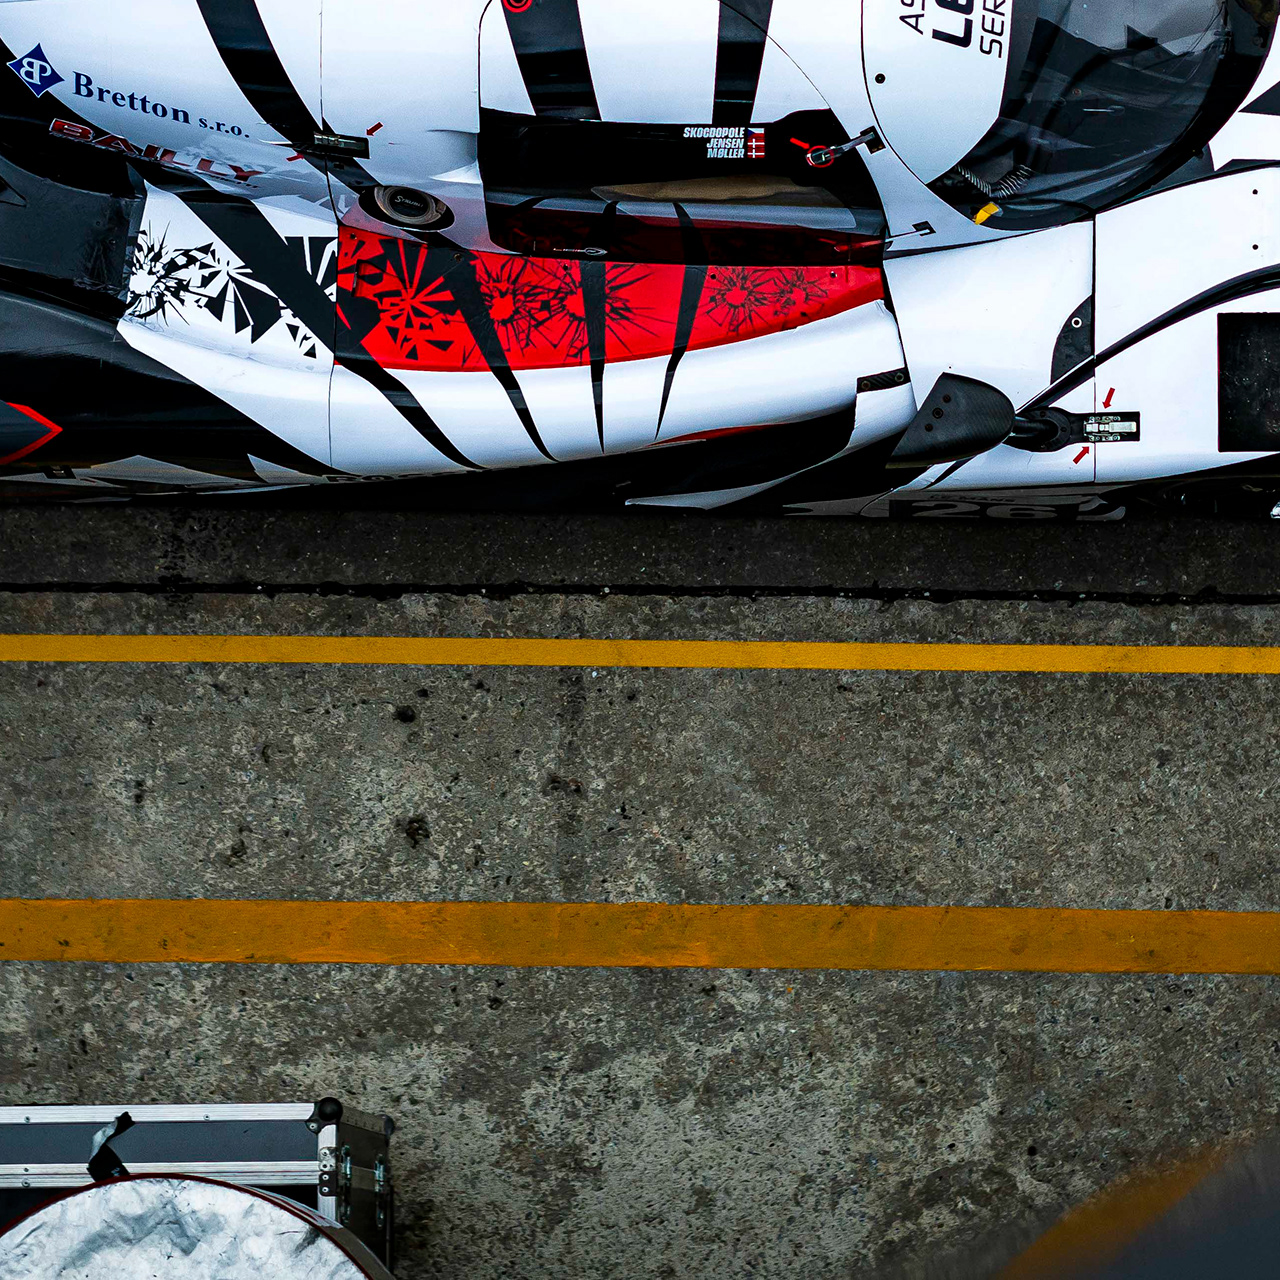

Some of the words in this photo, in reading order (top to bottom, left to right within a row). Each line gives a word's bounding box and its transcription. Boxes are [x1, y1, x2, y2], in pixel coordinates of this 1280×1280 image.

[72, 70, 192, 125] Bretton
[198, 116, 250, 138] s.r.o.
[49, 118, 263, 183] BAILLY
[706, 138, 744, 148] JENSEN
[912, 501, 1058, 519] 26
